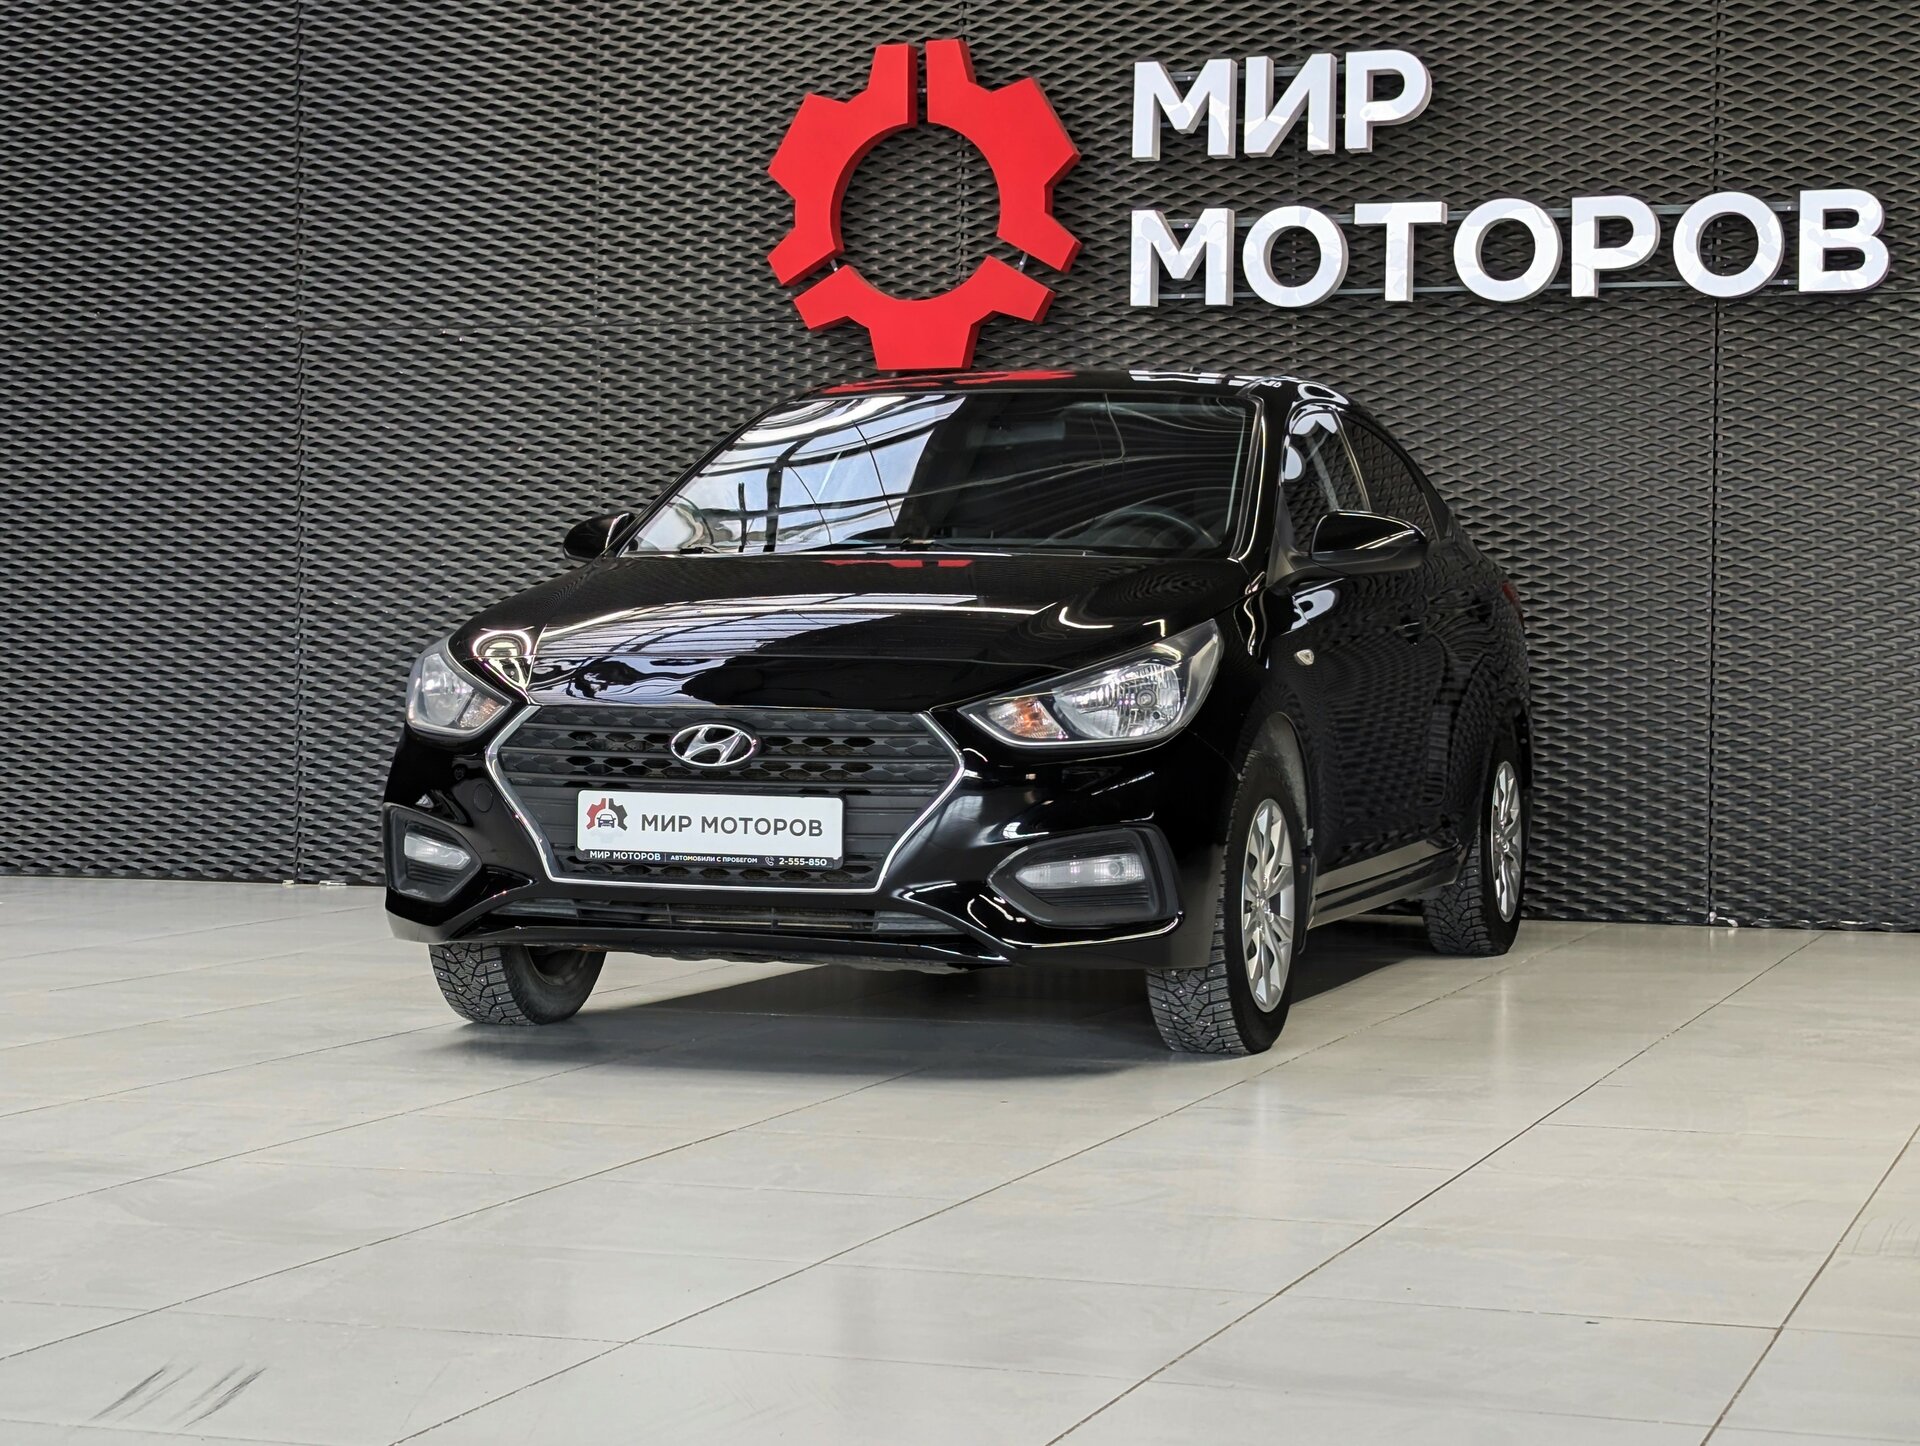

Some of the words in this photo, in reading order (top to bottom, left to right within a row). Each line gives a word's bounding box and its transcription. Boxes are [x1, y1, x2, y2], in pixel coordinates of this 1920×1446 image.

[1131, 49, 1432, 161] МИР
[1130, 188, 1891, 307] МОТОРОВ
[589, 850, 611, 859] МИР
[613, 852, 661, 861] МОТОРОВ
[670, 855, 715, 863] АВТОМОБИЛИ
[722, 856, 758, 864] ПРОБЕГОМ
[778, 857, 828, 867] 2-555-850
[641, 814, 692, 833] МИР
[701, 816, 823, 837] МОТОРОВ
